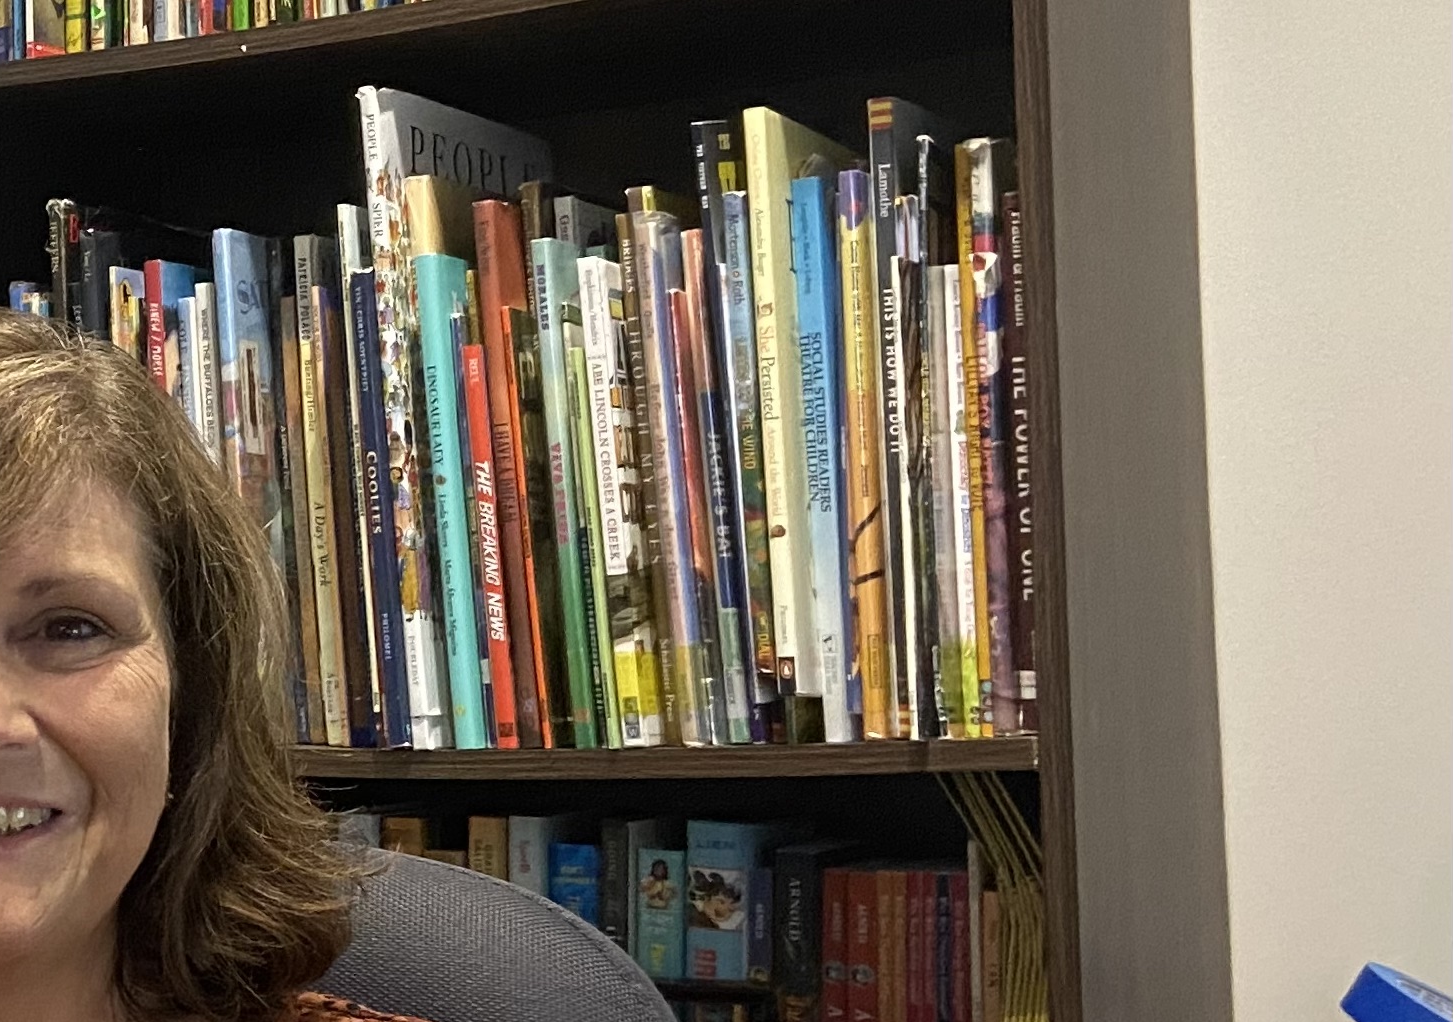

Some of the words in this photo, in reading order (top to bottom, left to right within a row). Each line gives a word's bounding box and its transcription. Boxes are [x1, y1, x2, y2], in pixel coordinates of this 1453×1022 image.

[365, 114, 378, 161] PEOPLE
[373, 202, 383, 237] SPIER
[877, 163, 891, 218] Lamothe
[727, 214, 742, 269] Mortenson
[298, 258, 310, 300] PATRICIA
[623, 239, 633, 293] BRIDGES
[536, 264, 549, 330] MORALES
[732, 280, 744, 305] Roth
[883, 287, 898, 321] THIS
[201, 308, 210, 340] WHERE
[759, 325, 774, 353] She
[884, 325, 898, 340] IS
[591, 363, 604, 386] ABE
[627, 316, 652, 435] THROUGH
[799, 336, 815, 396] THEATRE
[811, 331, 825, 383] SOCIAL
[885, 345, 898, 380] HOW
[1011, 354, 1027, 399] THE
[204, 364, 213, 417] BUFFALOES
[426, 365, 442, 430] DINOSAUR
[760, 356, 778, 422] Persisted
[887, 386, 898, 408] WE
[594, 389, 609, 446] LINCOLN
[801, 399, 817, 427] FOR
[813, 387, 829, 444] STUDIES
[888, 413, 899, 438] DO
[430, 433, 444, 466] LADY
[551, 442, 564, 483] VIVA
[640, 453, 654, 483] MY
[742, 435, 756, 470] WIND
[804, 430, 820, 502] CHILDREN
[366, 451, 382, 534] COOLIES
[474, 461, 492, 496] THE
[601, 451, 615, 503] CROSSES
[706, 432, 729, 516] JACKIE'S
[817, 449, 832, 512] READERS
[314, 502, 325, 511] A
[314, 515, 328, 550] Day's
[478, 501, 501, 585] BREAKING
[608, 519, 620, 560] CREEK
[645, 504, 662, 565] EYES
[317, 555, 331, 587] Work
[488, 592, 505, 641] NEWS
[758, 633, 770, 659] DIAL
[665, 694, 674, 722] Press
[788, 877, 801, 942] ARNOLD
